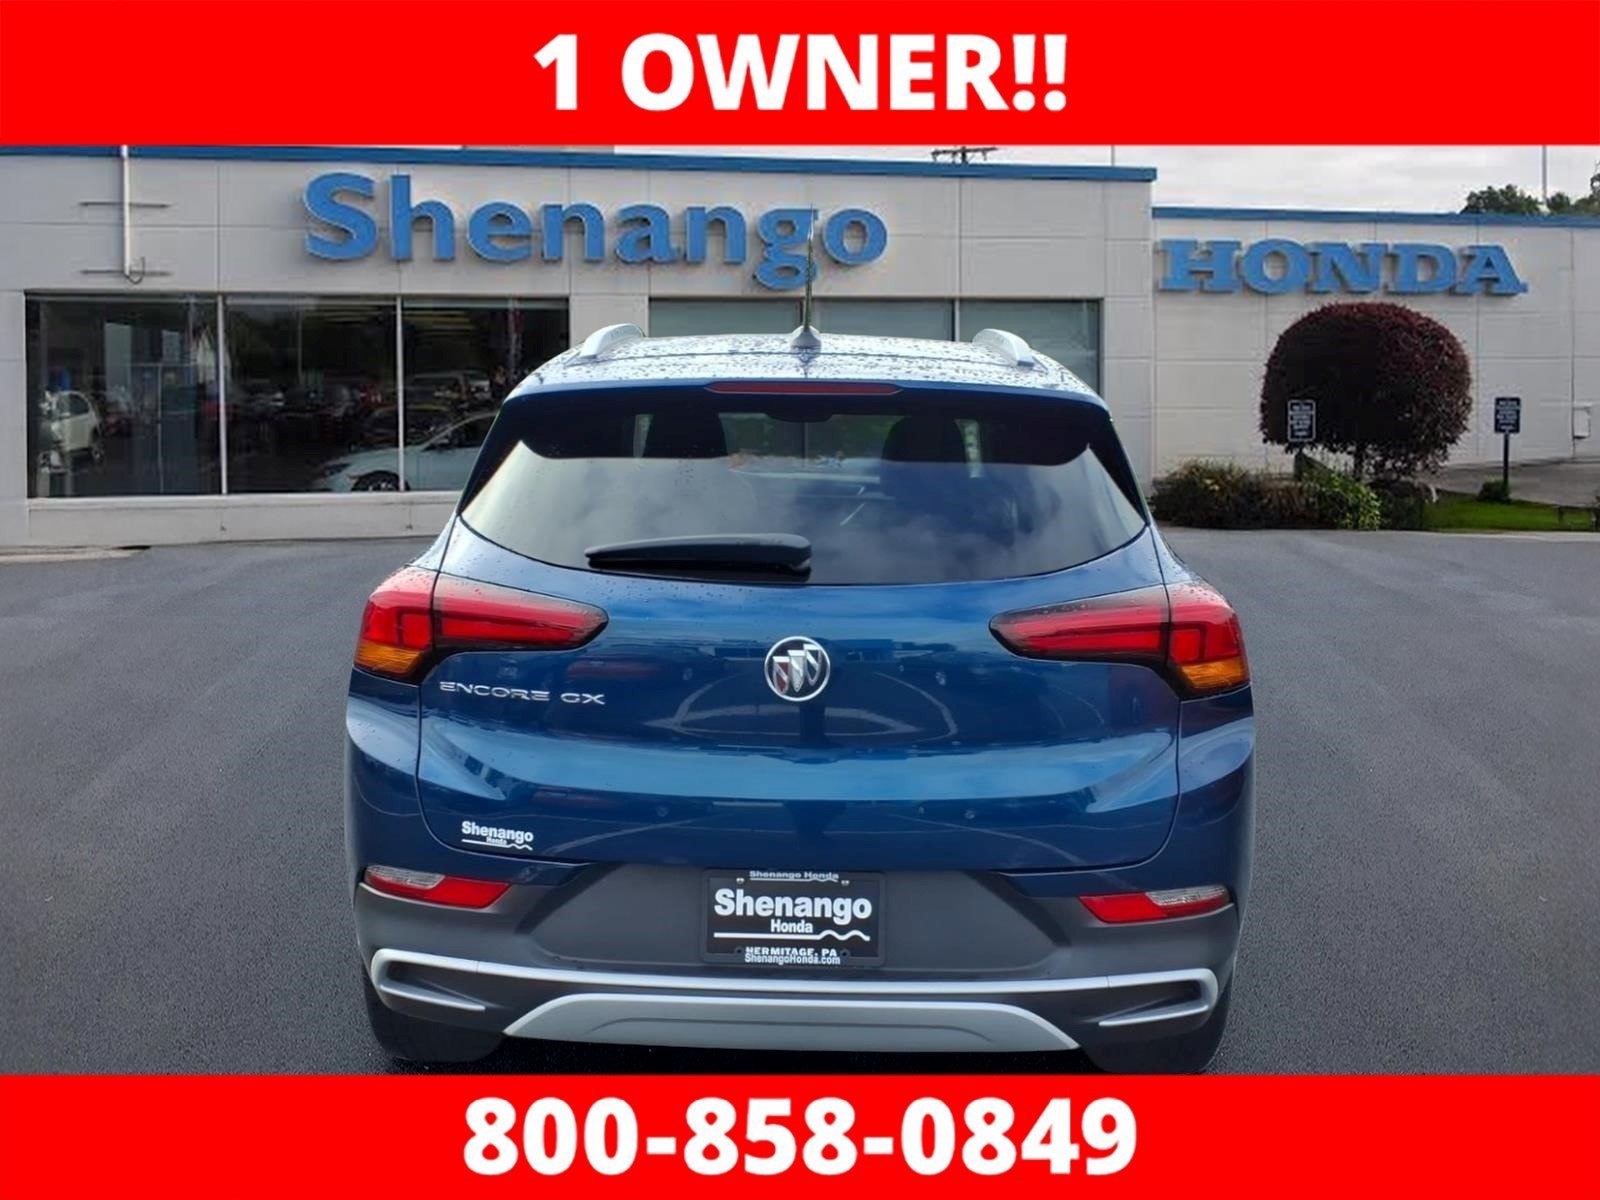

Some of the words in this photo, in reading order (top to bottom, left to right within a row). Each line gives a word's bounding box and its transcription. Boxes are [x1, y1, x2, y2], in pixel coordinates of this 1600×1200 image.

[303, 171, 888, 291] Shenango
[1157, 238, 1529, 294] HONDA
[439, 681, 550, 701] ENCORE
[560, 692, 605, 705] GX
[461, 820, 534, 844] Shenango
[486, 835, 508, 846] Honda
[749, 870, 802, 880] Shenango
[804, 871, 840, 880] Honda
[714, 887, 873, 926] Shenango
[770, 918, 814, 934] Honda
[744, 952, 841, 966] ShenangoHonda.com
[821, 948, 838, 957] PA
